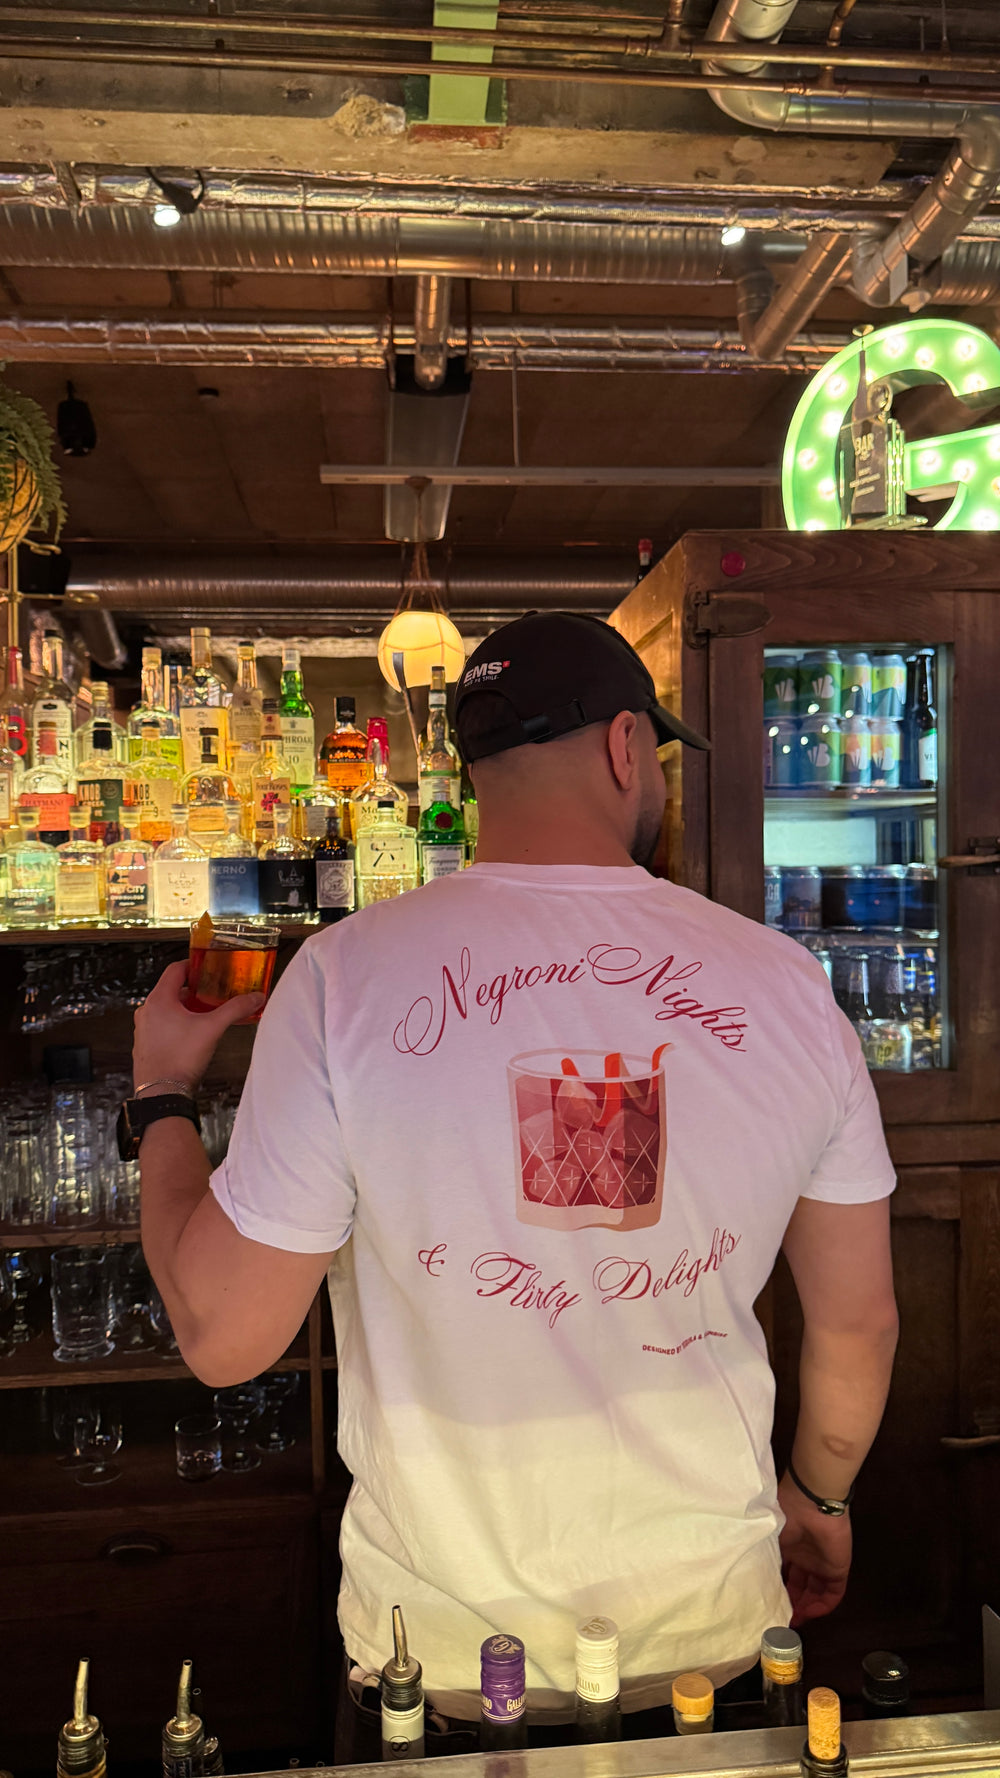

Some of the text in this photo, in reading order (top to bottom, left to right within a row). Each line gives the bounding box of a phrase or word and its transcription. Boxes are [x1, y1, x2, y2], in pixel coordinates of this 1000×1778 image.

[854, 432, 875, 456] BAR
[289, 754, 300, 765] 10
[211, 863, 247, 875] HERNÖ
[393, 943, 747, 1056] Negroni Nights
[470, 1251, 582, 1329] Flirty
[592, 1227, 742, 1305] Delights
[642, 1344, 676, 1355] DESIGNED
